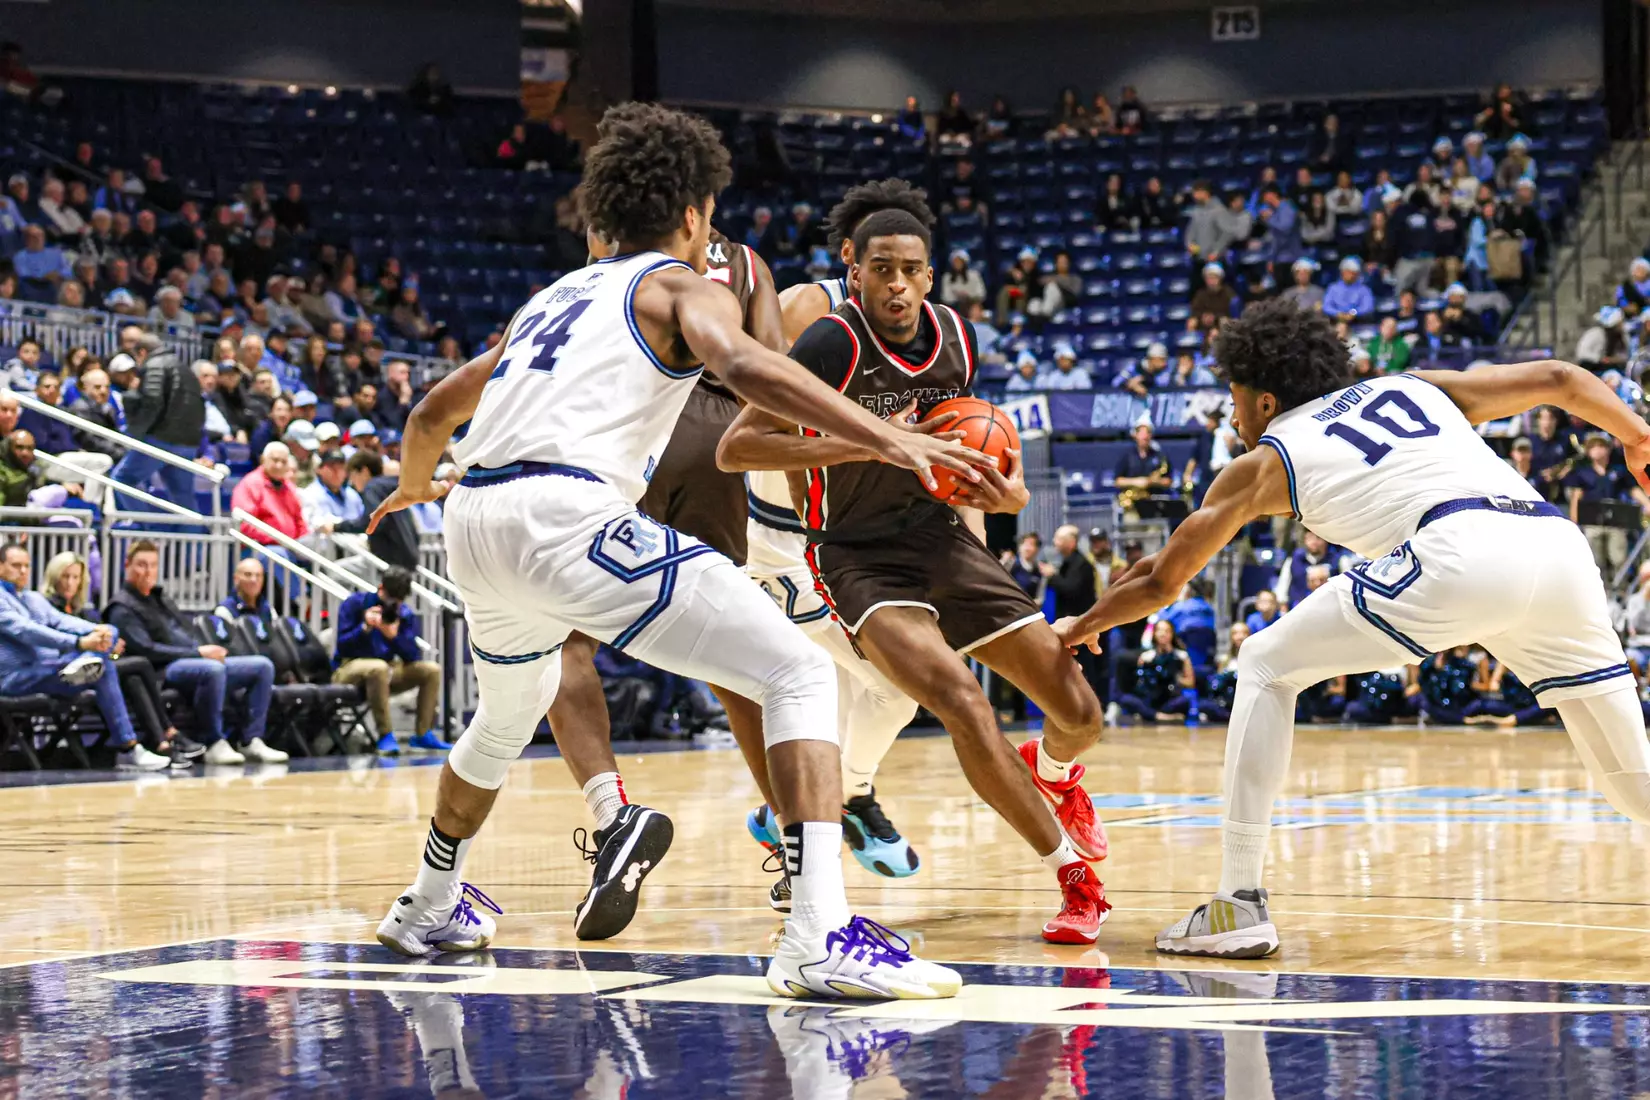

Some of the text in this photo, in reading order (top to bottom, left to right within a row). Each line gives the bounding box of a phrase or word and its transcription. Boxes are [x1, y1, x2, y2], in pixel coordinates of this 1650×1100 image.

[489, 299, 595, 379] 24
[1311, 382, 1374, 422] BROWN
[1323, 389, 1441, 467] 10
